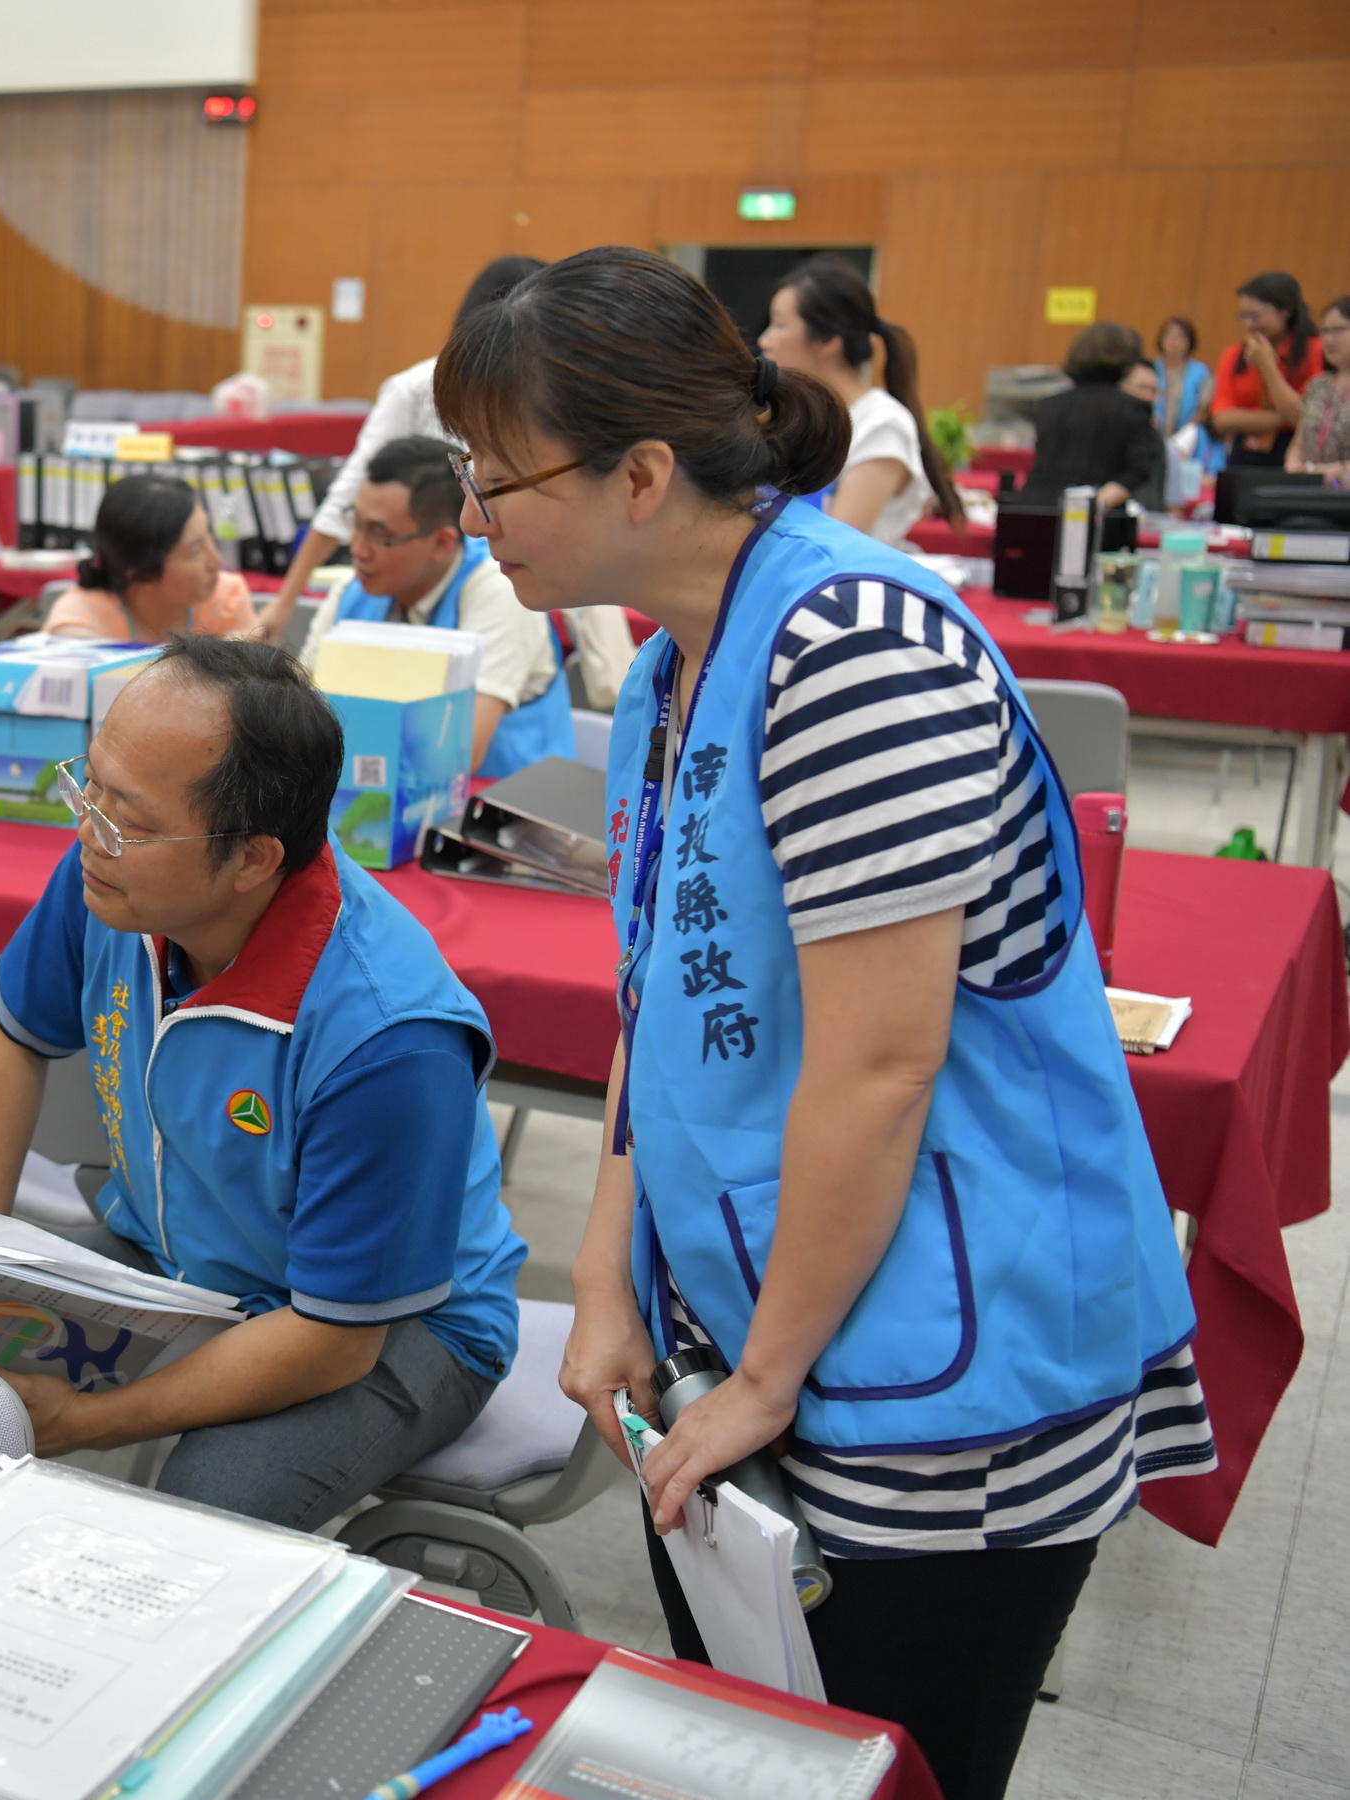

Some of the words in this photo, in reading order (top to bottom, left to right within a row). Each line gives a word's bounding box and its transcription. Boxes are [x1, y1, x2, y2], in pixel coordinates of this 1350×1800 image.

[2, 681, 14, 694] A
[672, 742, 760, 1065] 南投縣政府
